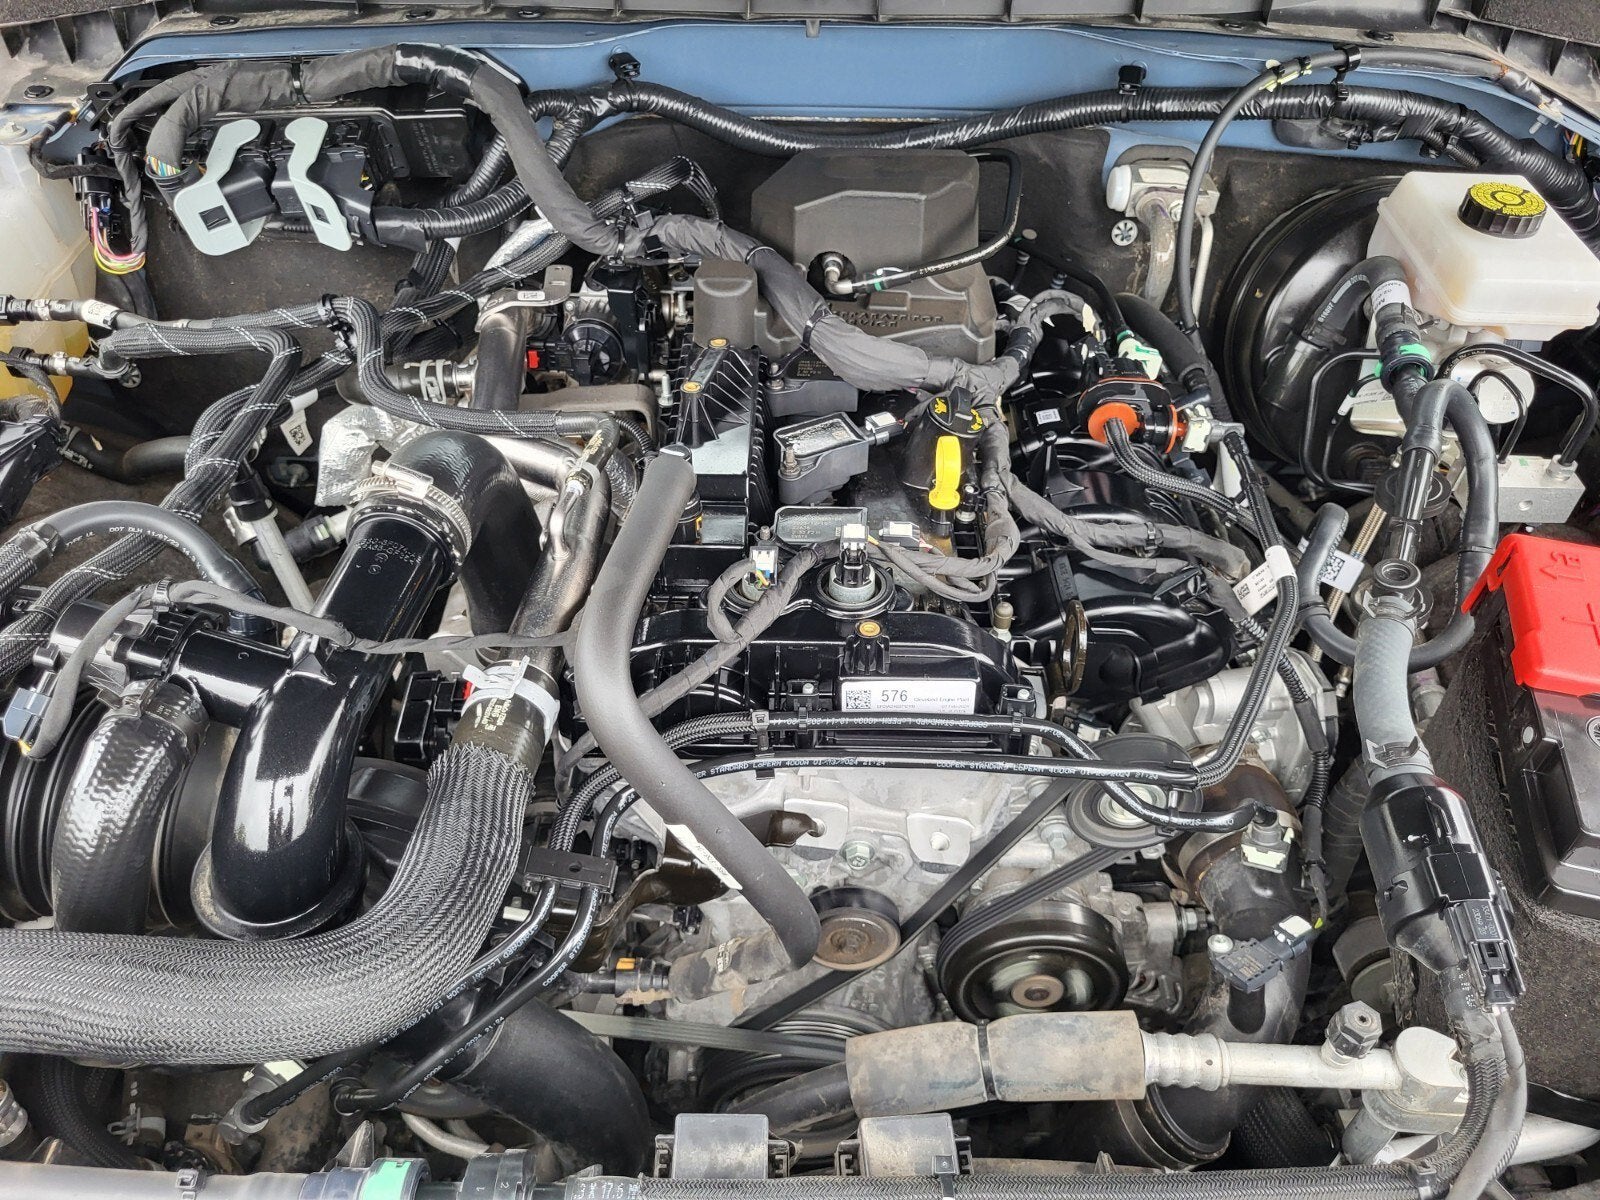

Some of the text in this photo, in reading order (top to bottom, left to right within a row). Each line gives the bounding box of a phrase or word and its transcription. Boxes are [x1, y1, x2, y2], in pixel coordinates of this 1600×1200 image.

[881, 689, 908, 702] 576
[710, 762, 750, 775] STANDARD
[936, 760, 966, 769] COOPER
[969, 761, 1009, 771] STANDARD
[542, 961, 569, 987] COOPER
[568, 914, 594, 960] STANDARD
